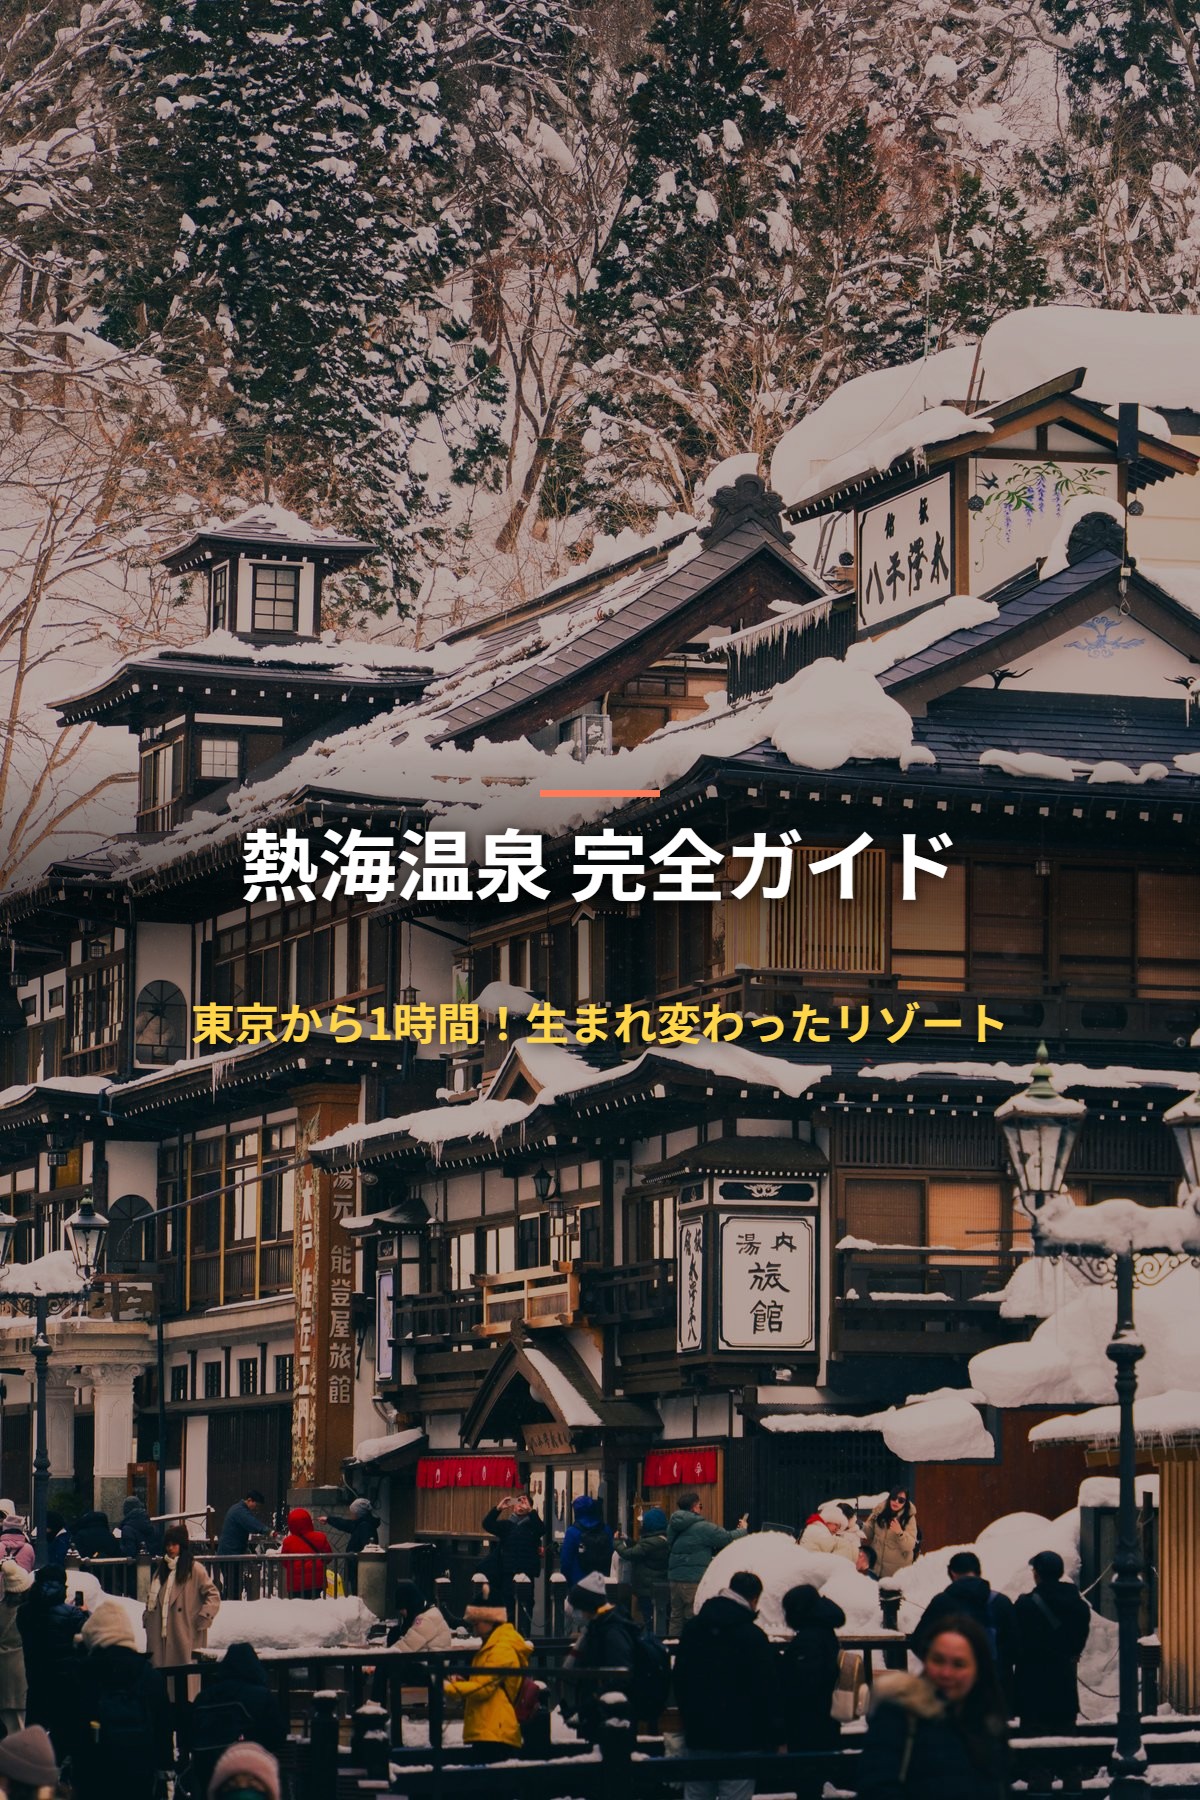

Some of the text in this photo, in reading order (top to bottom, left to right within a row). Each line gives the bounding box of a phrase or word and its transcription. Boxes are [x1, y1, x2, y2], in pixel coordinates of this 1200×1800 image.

[329, 1244, 352, 1405] 能登屋旅館
[748, 1261, 790, 1335] 旅館
